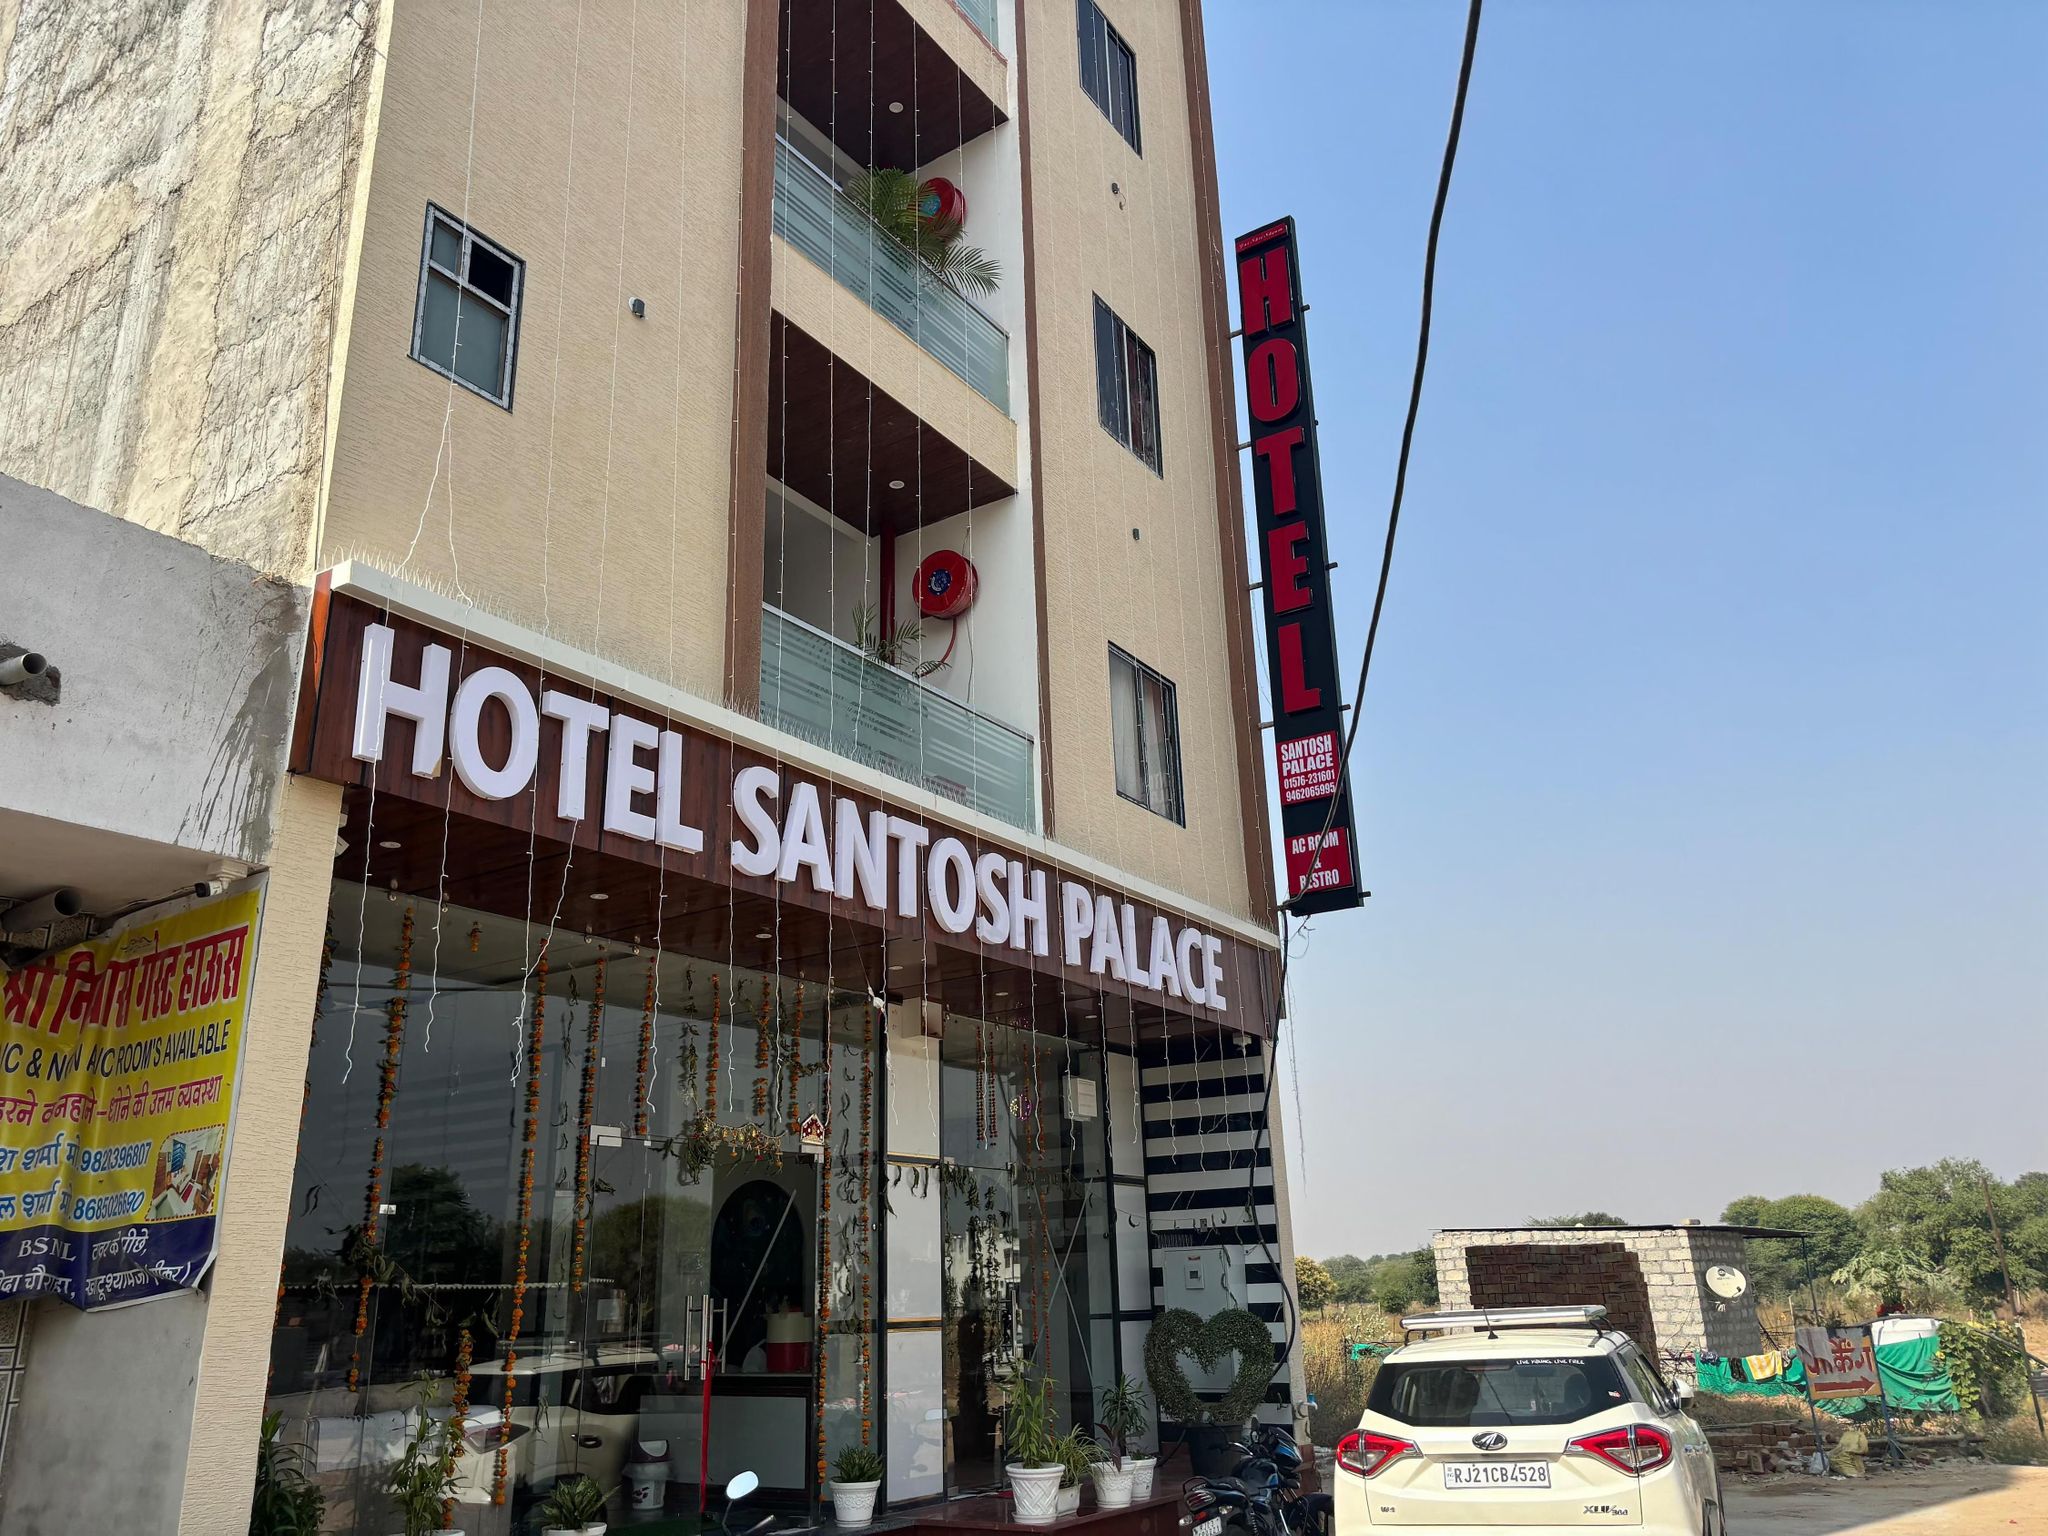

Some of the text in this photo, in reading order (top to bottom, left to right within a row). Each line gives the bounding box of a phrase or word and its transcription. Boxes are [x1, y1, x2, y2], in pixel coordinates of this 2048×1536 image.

[1240, 246, 1322, 714] HOTEL
[1281, 734, 1332, 761] SANTOSH
[1282, 752, 1334, 777] PALACE
[1284, 769, 1335, 790] 01576-231601
[1286, 781, 1336, 802] 9462065995
[352, 622, 1227, 1012] HOTEL SANTOSH PALACE
[1292, 838, 1306, 855] AC
[0, 1042, 23, 1073] /C
[26, 1048, 42, 1078] &
[115, 1037, 162, 1076] ROOM'S
[163, 1019, 231, 1065] AVAILABLE
[17, 1237, 77, 1261] BSNL
[1455, 1465, 1547, 1483] RJ21CB4528
